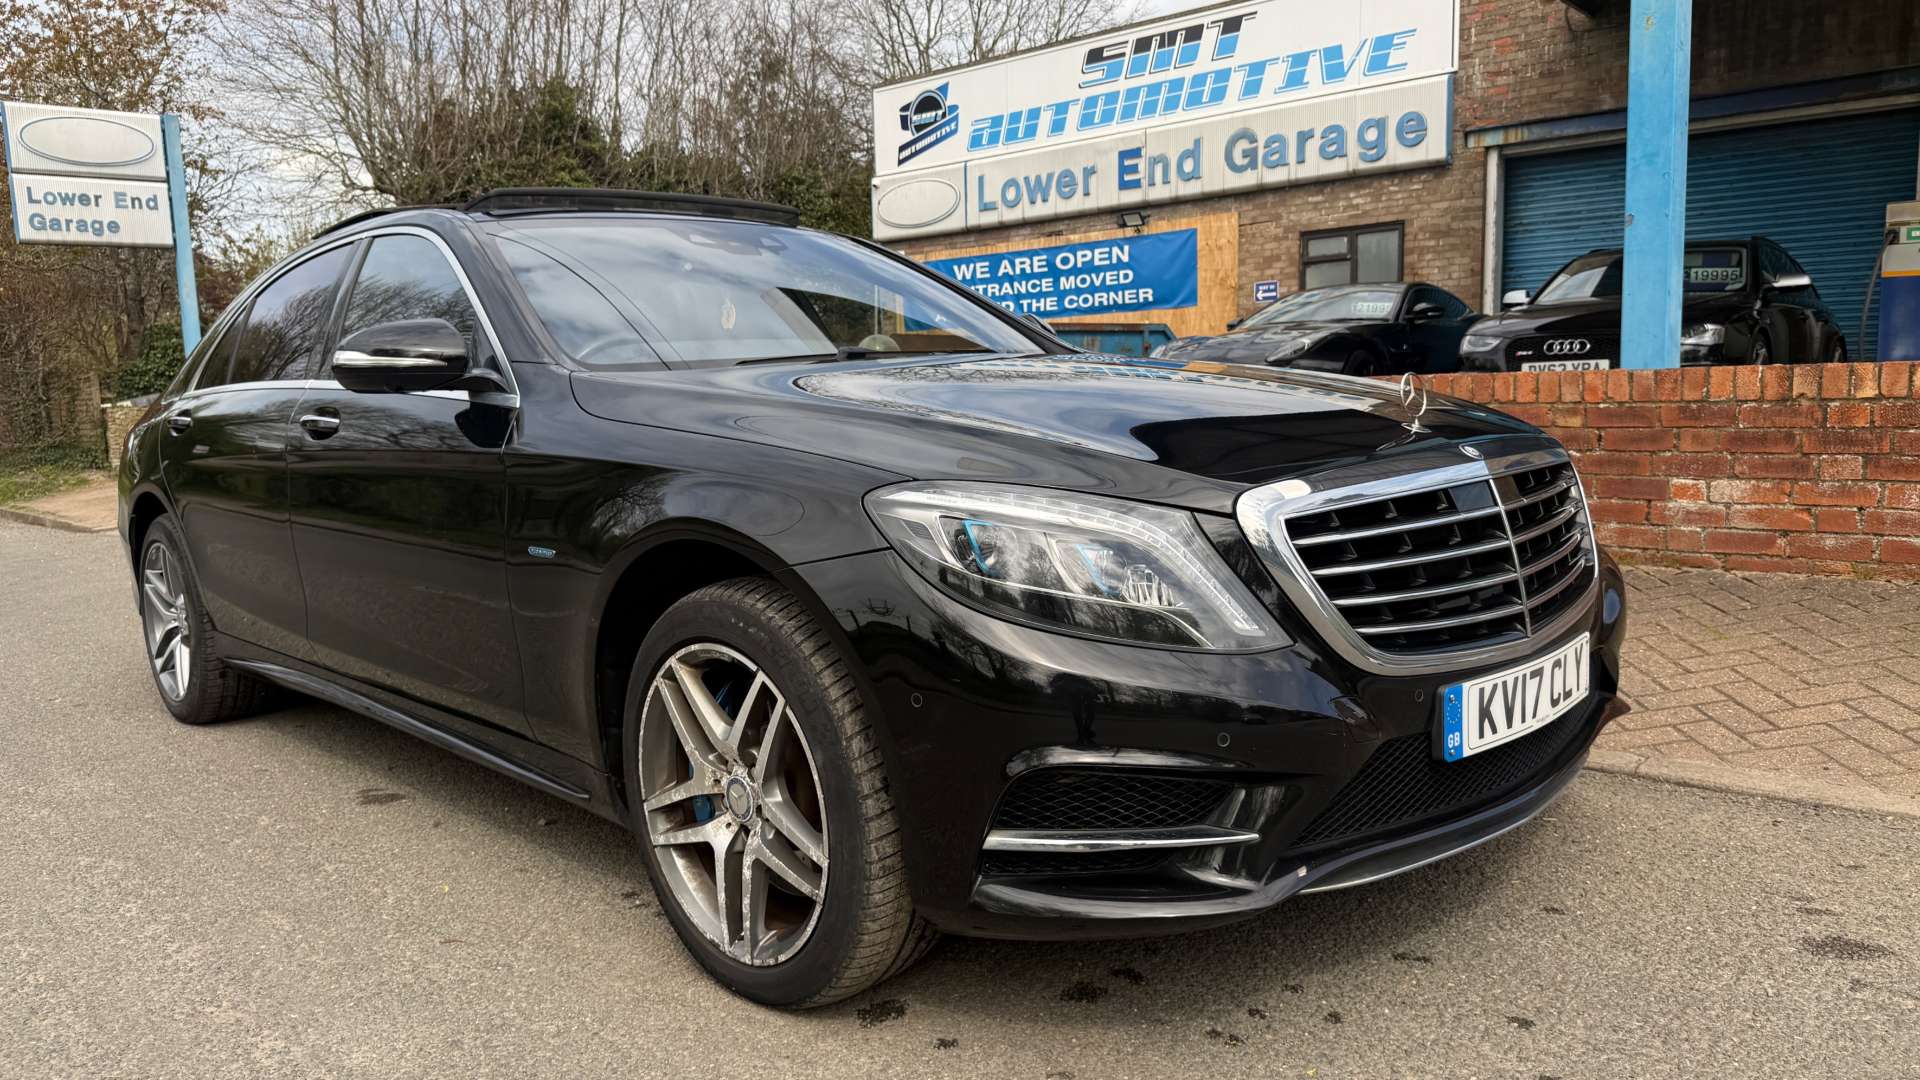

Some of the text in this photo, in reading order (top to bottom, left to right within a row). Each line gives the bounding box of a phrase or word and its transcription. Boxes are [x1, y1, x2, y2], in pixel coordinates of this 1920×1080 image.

[1078, 11, 1258, 89] SMT
[967, 28, 1418, 152] AUTOMOTIVE
[978, 111, 1428, 212] Lower End Garage
[26, 186, 159, 211] Lower End
[28, 212, 121, 237] Garage
[953, 245, 1130, 281] WE ARE OPEN
[1693, 270, 1738, 281] 19995
[970, 269, 1134, 298] TRANCE MOVED
[1019, 297, 1059, 313] THE
[1063, 288, 1154, 309] CORNER
[1478, 643, 1584, 740] KV17 CLY
[1447, 732, 1460, 749] GB
